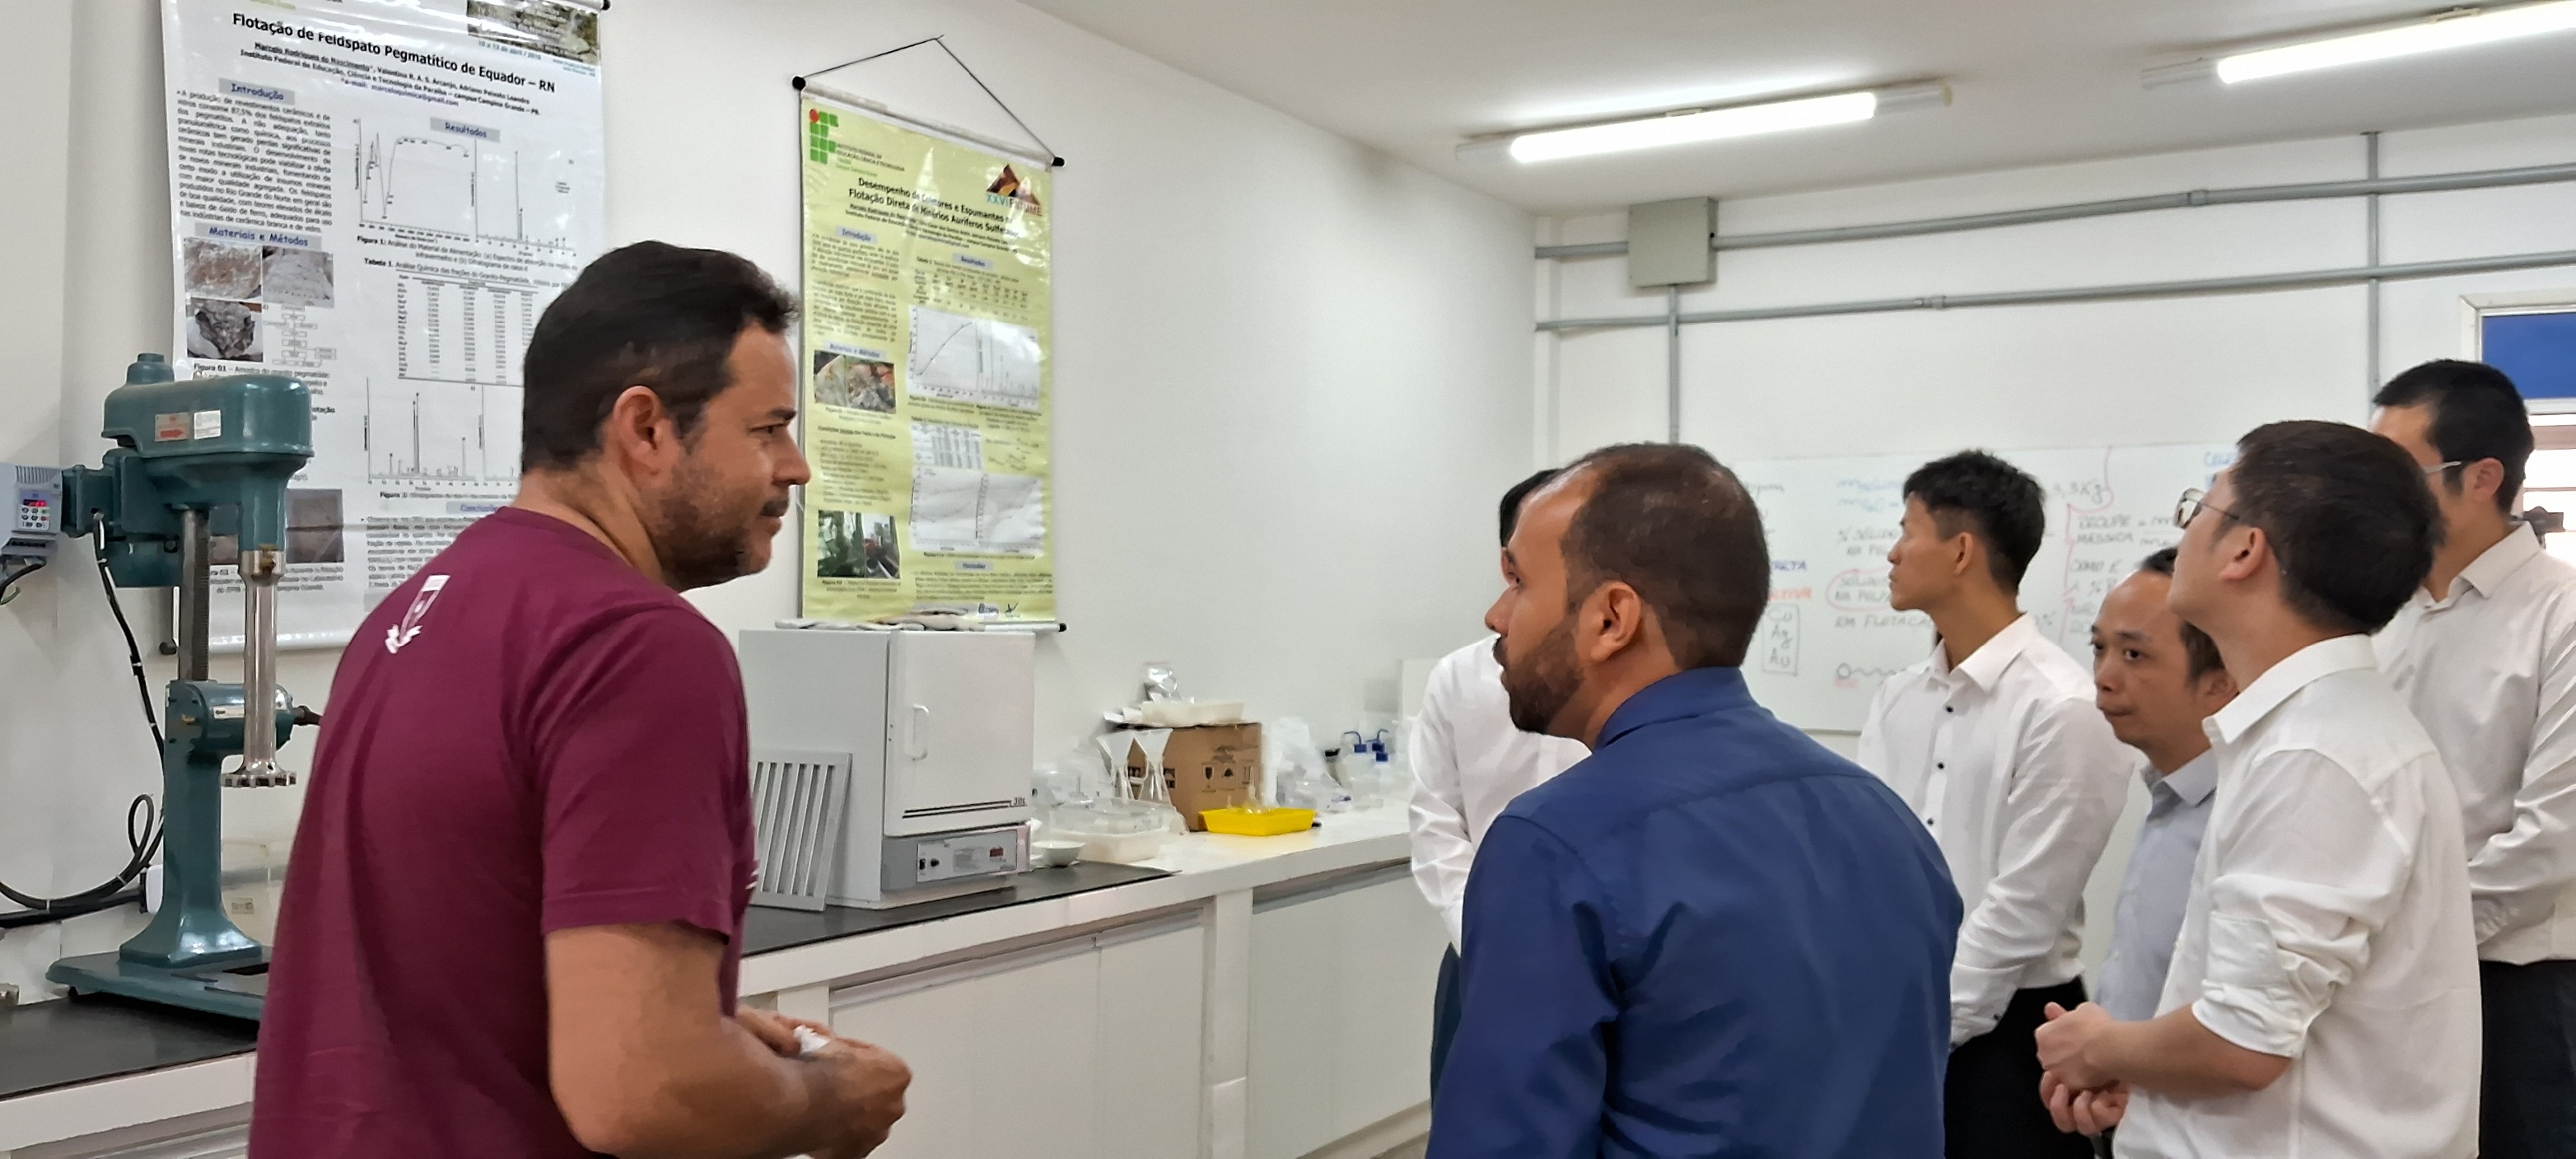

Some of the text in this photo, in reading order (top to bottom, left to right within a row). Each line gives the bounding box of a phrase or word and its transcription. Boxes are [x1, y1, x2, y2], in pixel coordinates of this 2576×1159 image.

[233, 13, 293, 36] Flotação
[297, 26, 314, 40] de
[385, 44, 458, 71] Pegmatítico
[461, 63, 475, 74] de
[479, 67, 525, 86] Equador
[539, 79, 555, 92] RN
[231, 83, 283, 100] Introdução
[445, 122, 487, 138] Resultados
[849, 188, 884, 204] Flotação
[886, 197, 910, 210] Direta
[859, 177, 911, 198] Desempenho
[961, 205, 1004, 222] Espumantes
[209, 227, 255, 241] Materiais
[269, 233, 308, 246] Métodos
[194, 363, 216, 372] Figura
